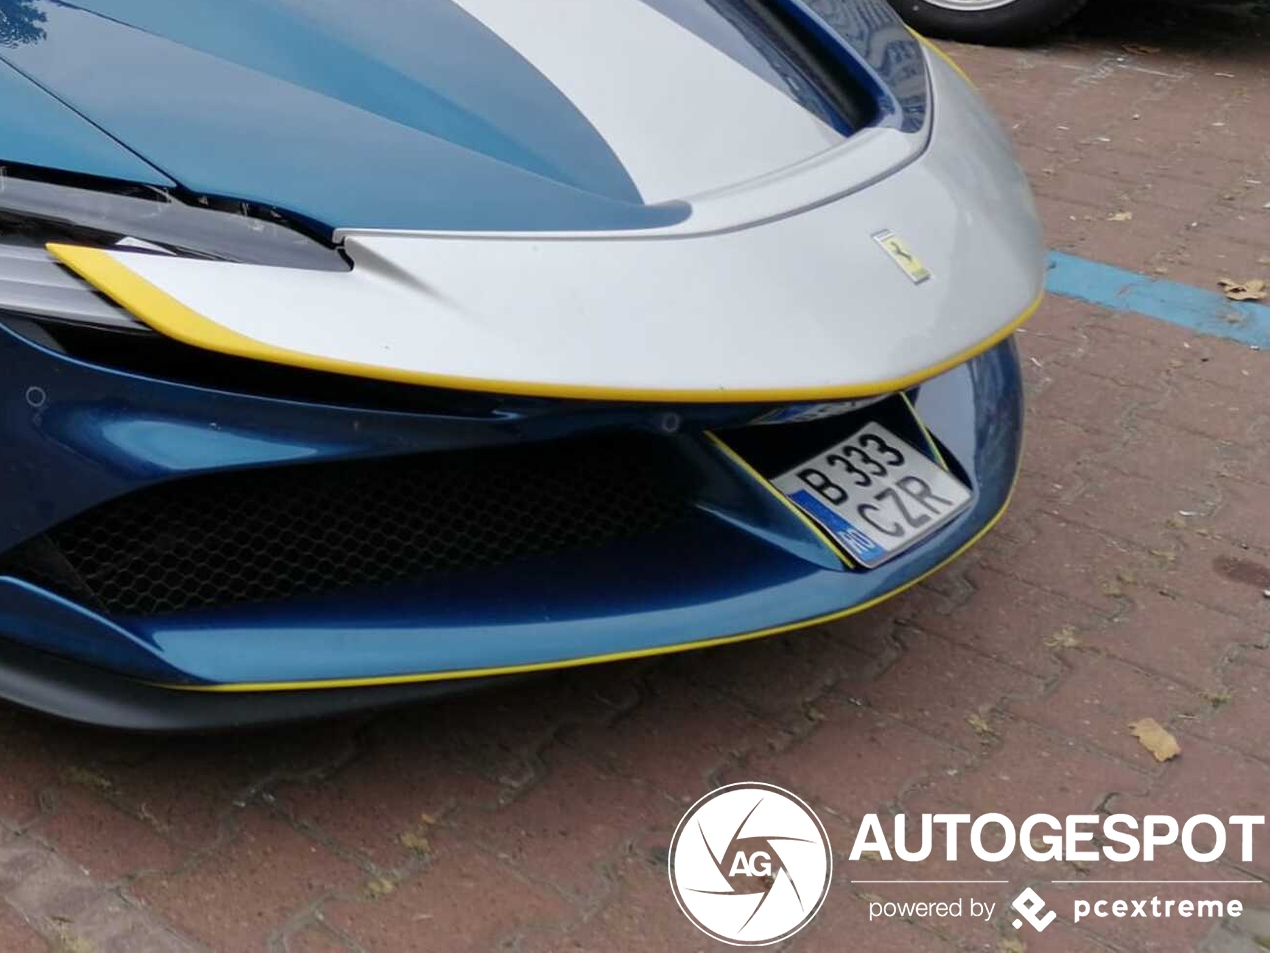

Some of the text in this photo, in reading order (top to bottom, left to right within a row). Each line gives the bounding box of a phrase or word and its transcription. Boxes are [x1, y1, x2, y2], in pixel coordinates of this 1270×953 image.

[795, 433, 905, 506] B 333
[857, 476, 954, 538] CZR
